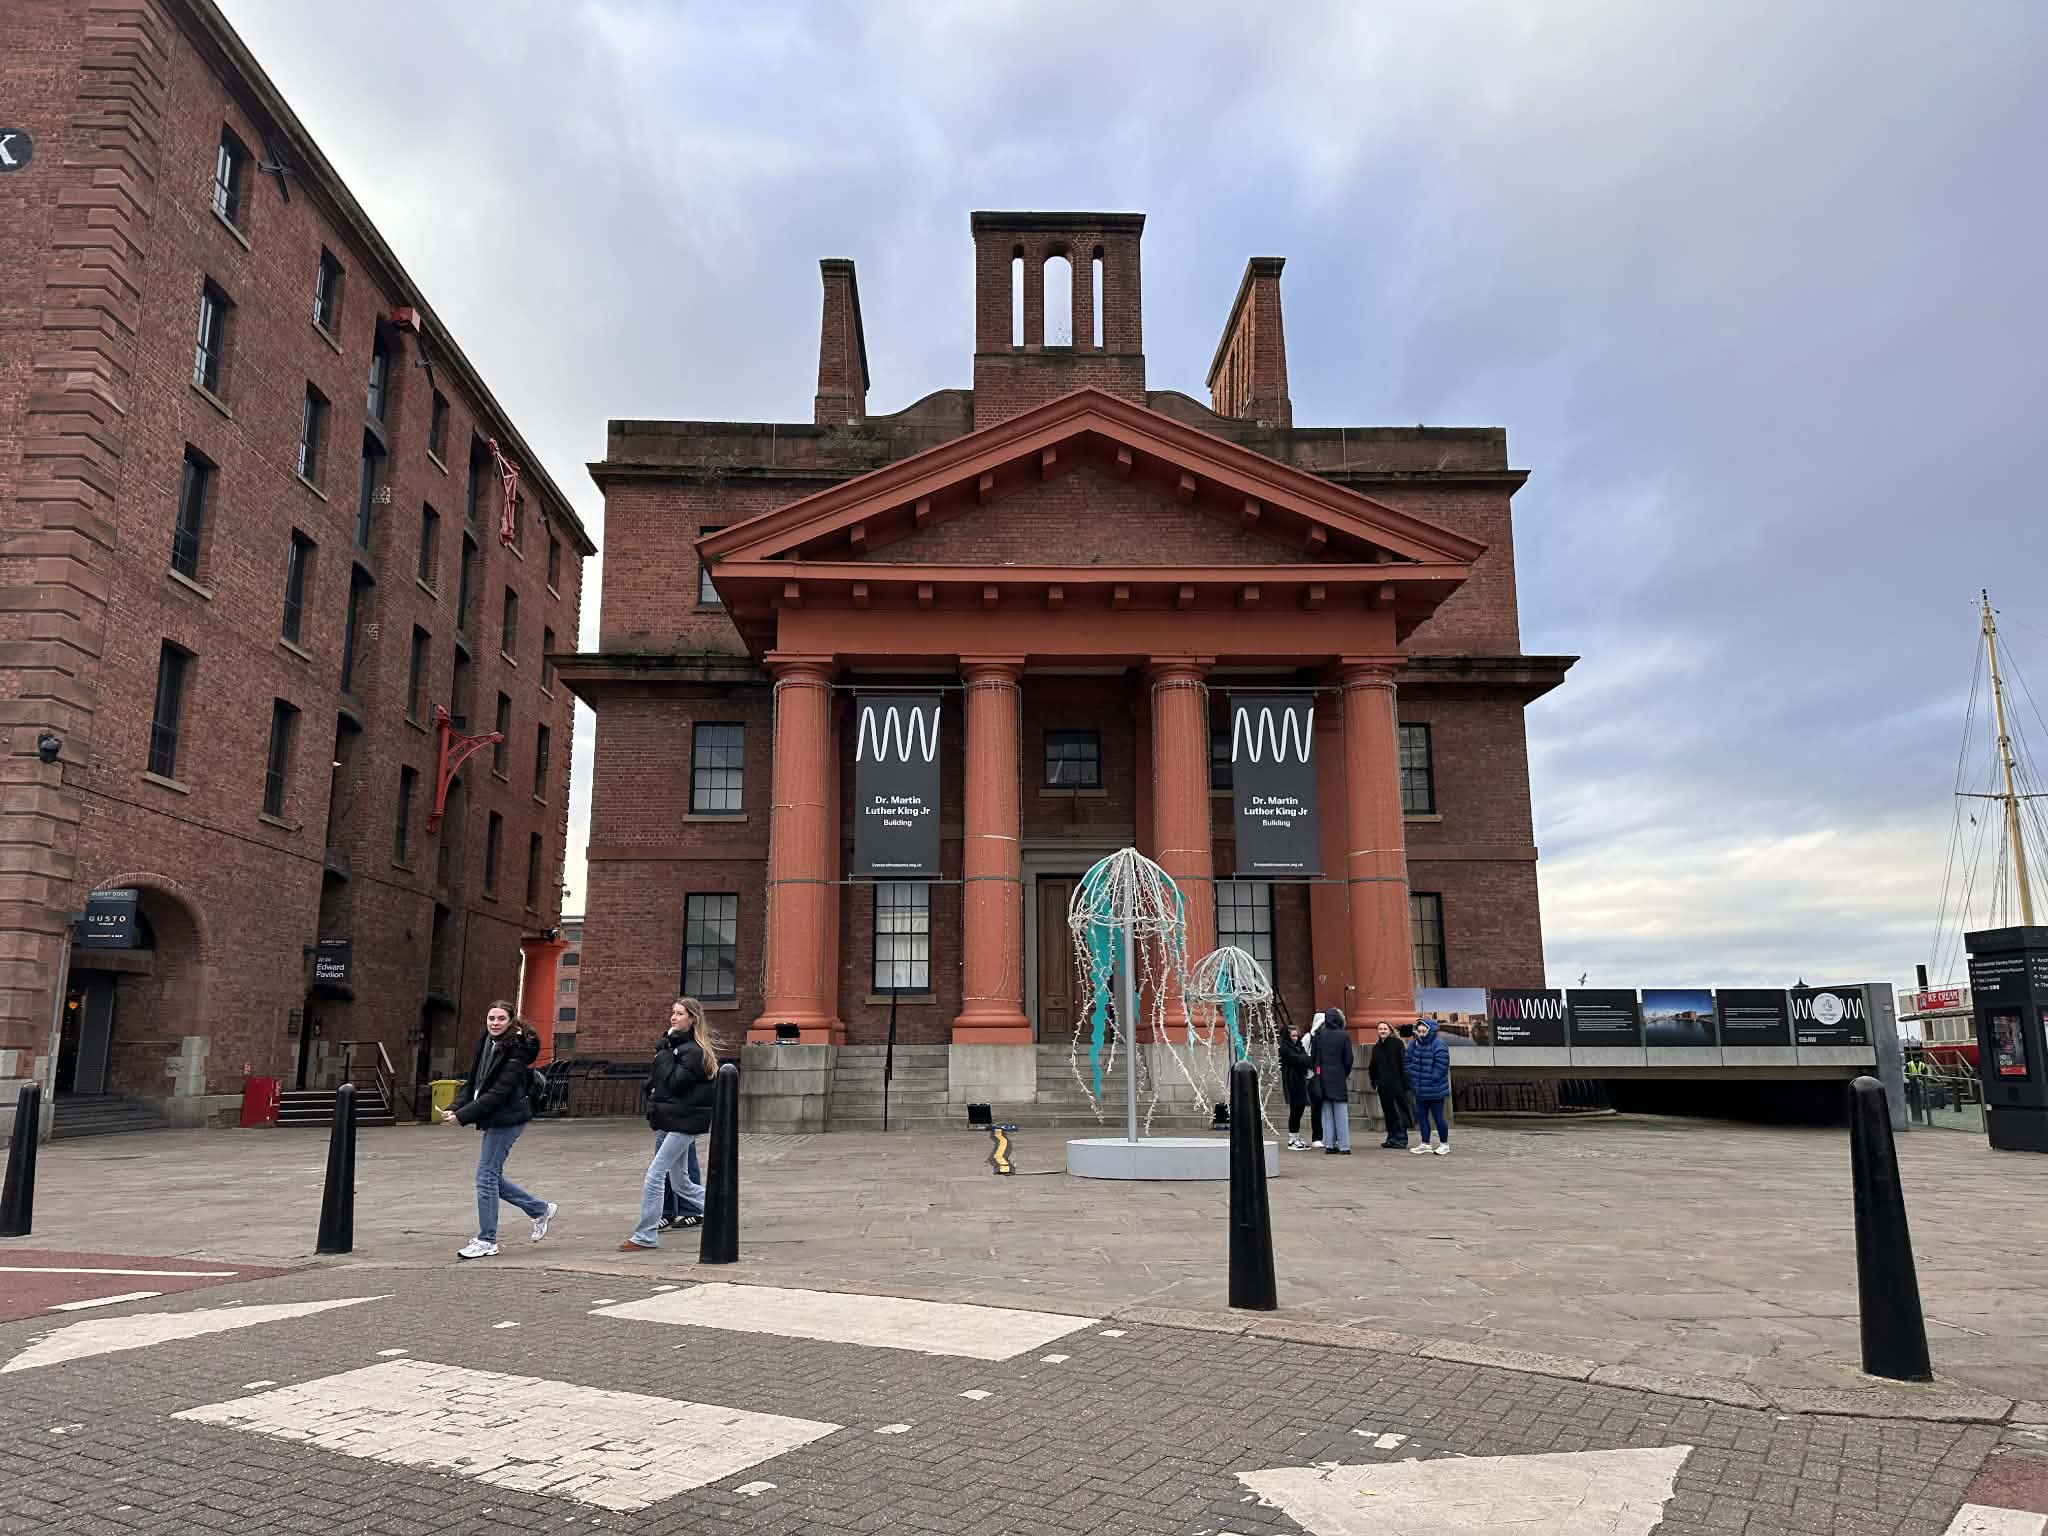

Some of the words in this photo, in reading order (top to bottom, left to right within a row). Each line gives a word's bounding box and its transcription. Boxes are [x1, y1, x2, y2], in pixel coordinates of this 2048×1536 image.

[875, 795, 889, 804] Dr.
[890, 795, 921, 804] Martin
[1252, 796, 1267, 805] Dr.
[1268, 796, 1298, 805] Martin
[865, 806, 896, 815] Luther
[897, 806, 919, 817] King
[920, 806, 931, 815] Jr
[1243, 807, 1274, 815] Luther
[1275, 807, 1297, 817] King
[1298, 807, 1308, 815] Jr
[883, 819, 913, 827] Building
[1262, 819, 1291, 828] Building
[316, 963, 345, 971] Edward
[316, 970, 344, 978] Pavilion
